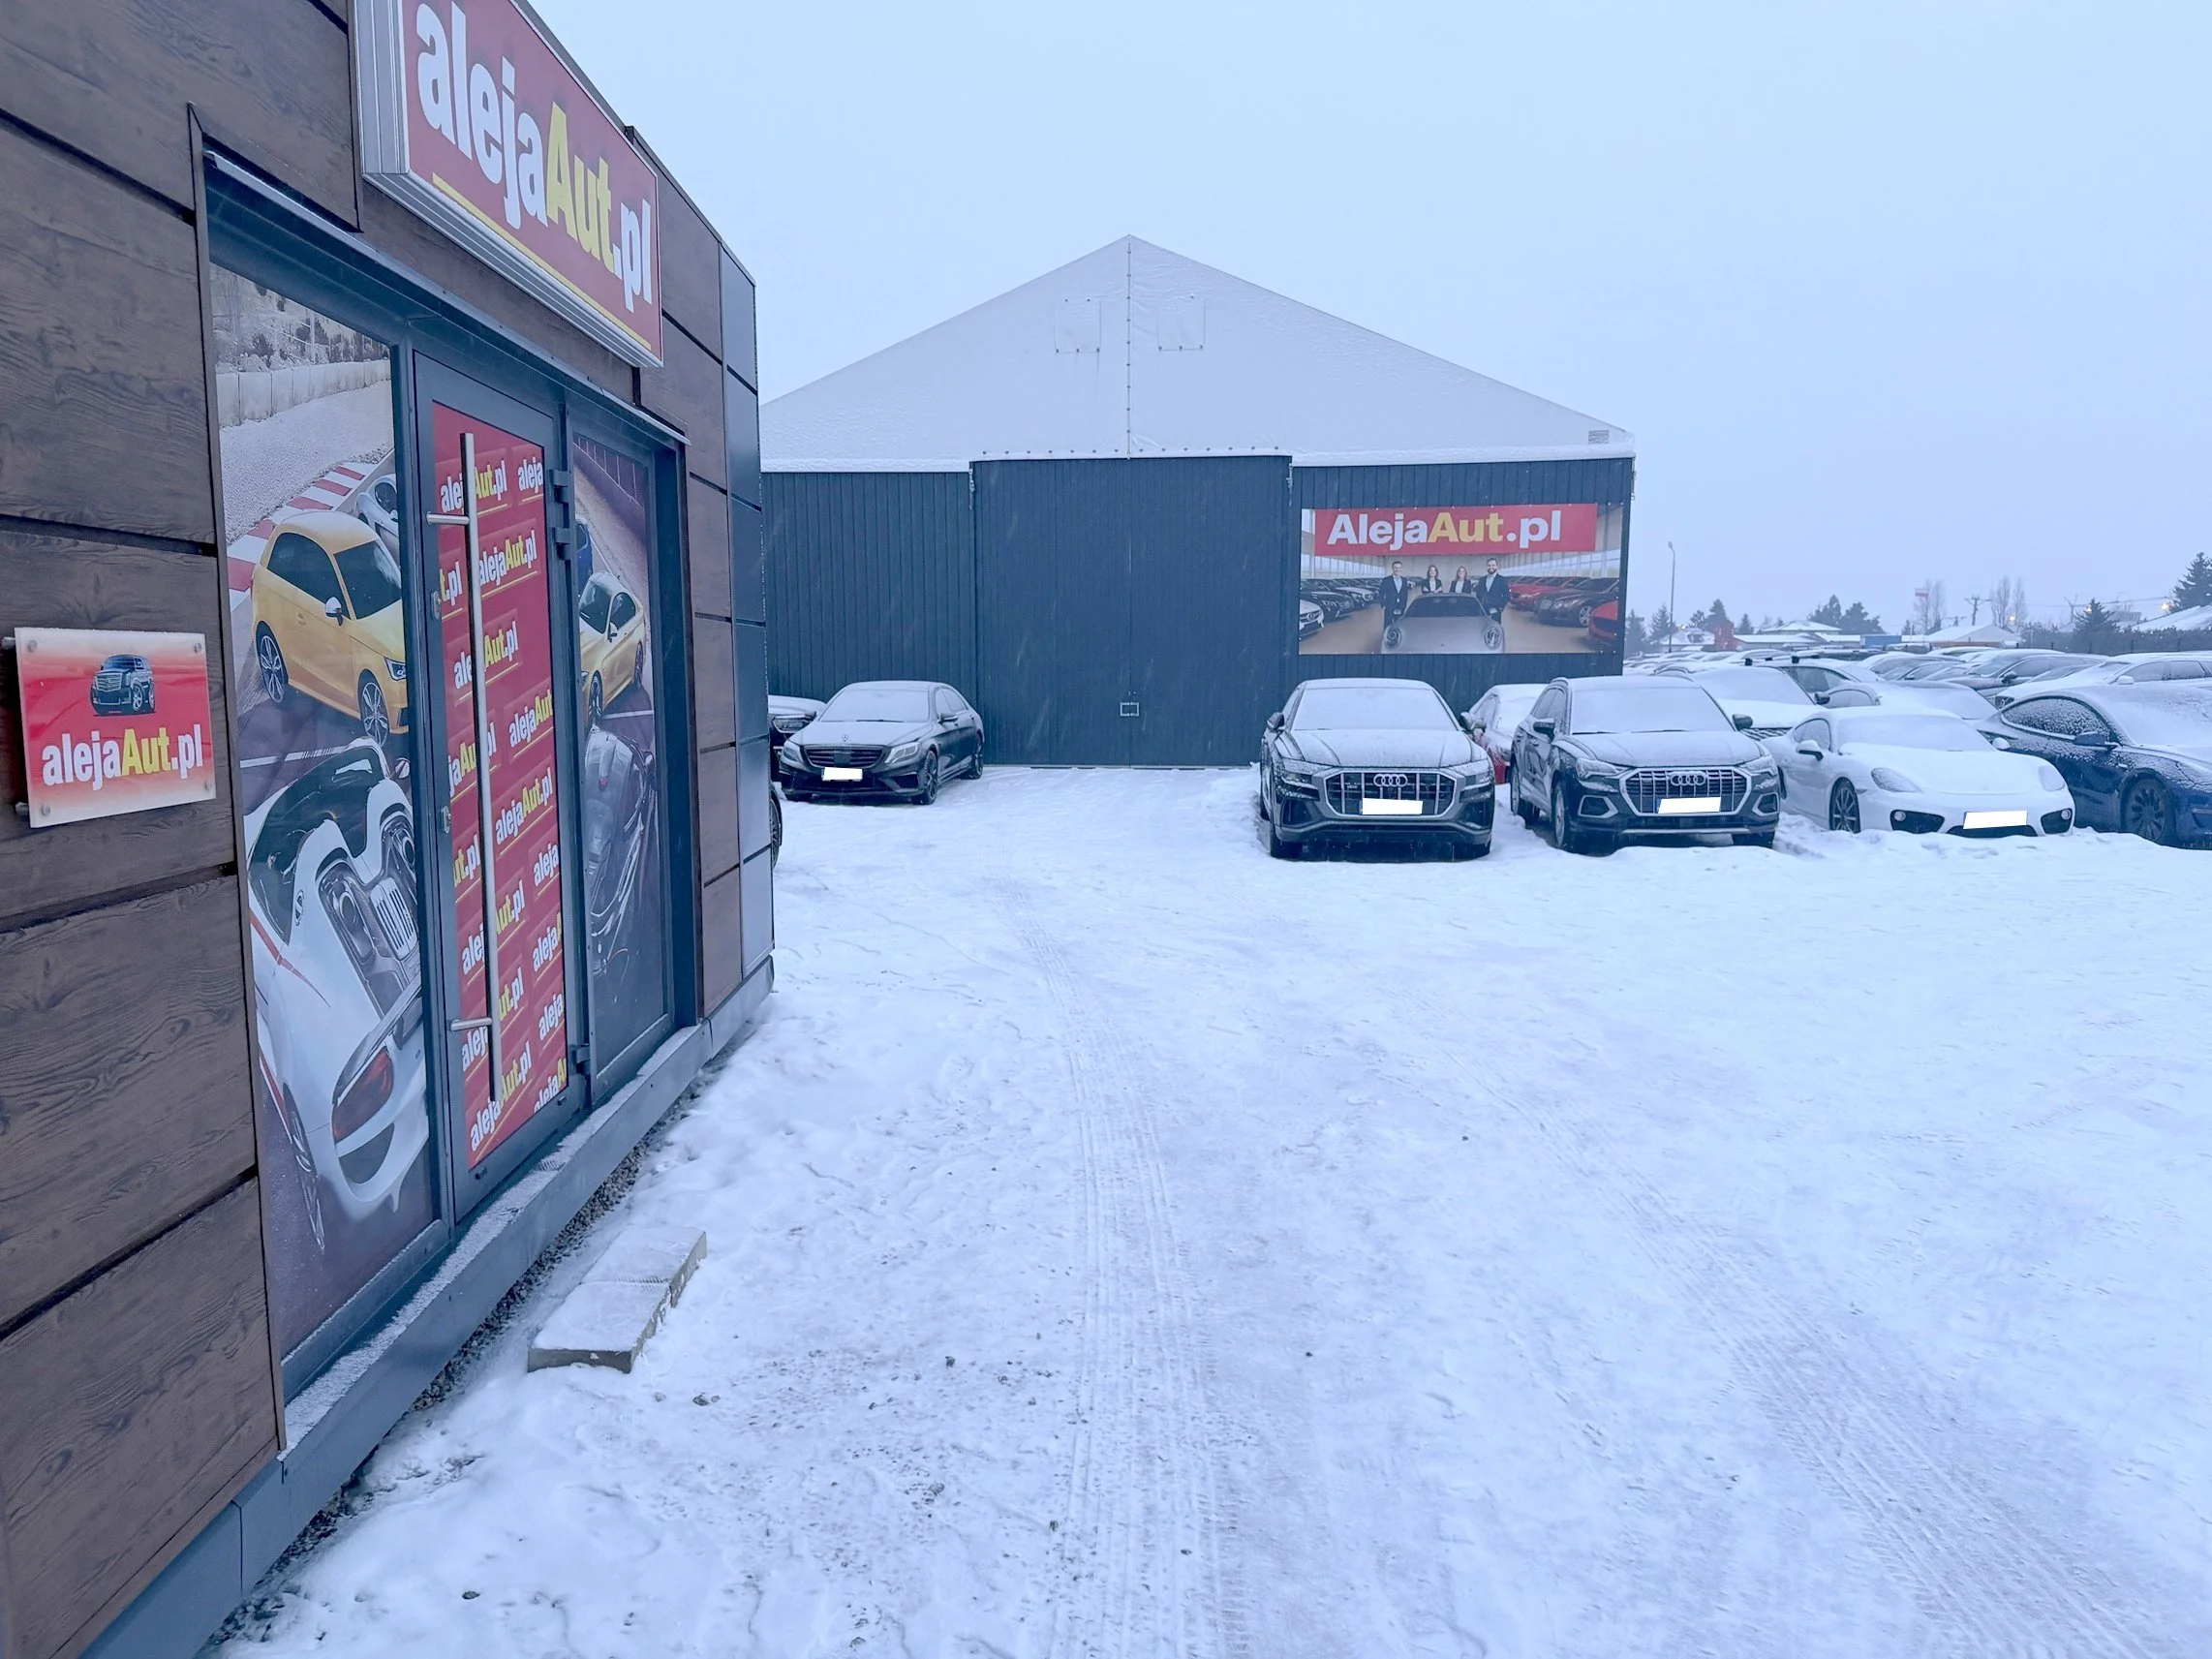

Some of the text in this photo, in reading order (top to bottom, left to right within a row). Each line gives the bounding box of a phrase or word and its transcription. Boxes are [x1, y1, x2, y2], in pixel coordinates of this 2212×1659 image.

[416, 1, 652, 313] alejaAut.pl
[1328, 509, 1561, 551] AlejaAut.pl
[42, 723, 203, 791] alejaAut.pl
[496, 767, 553, 845] alejaAut.pl
